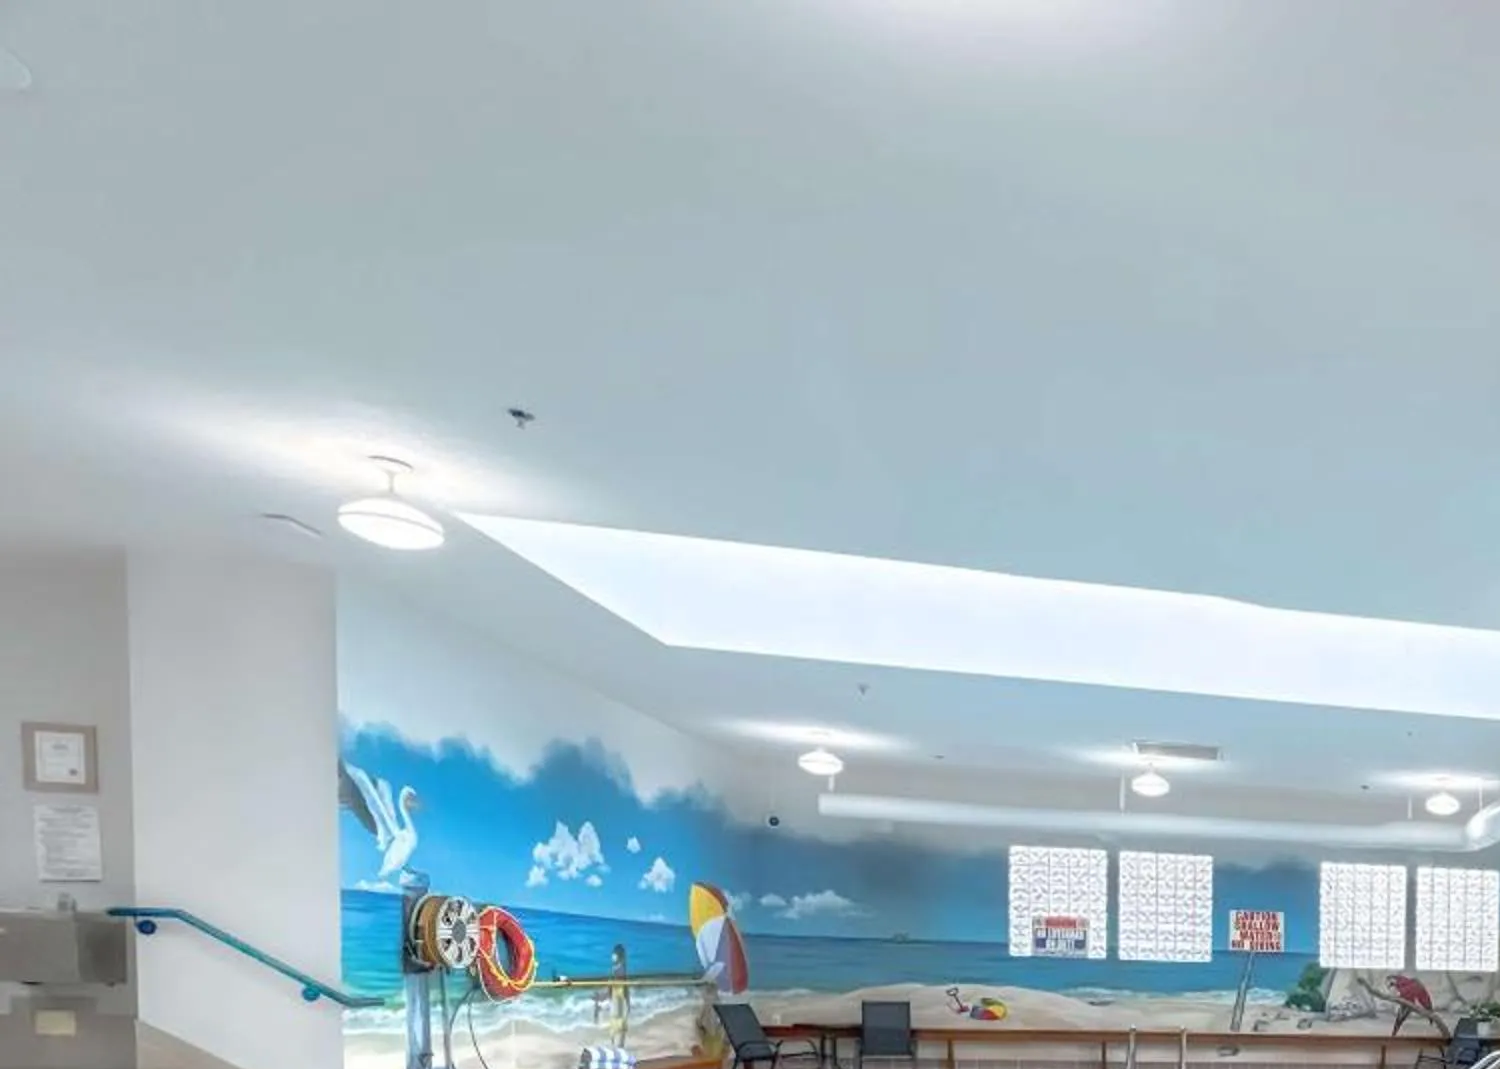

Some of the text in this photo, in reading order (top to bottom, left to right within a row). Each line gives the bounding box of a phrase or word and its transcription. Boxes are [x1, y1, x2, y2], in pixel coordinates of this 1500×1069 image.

[1235, 911, 1277, 921] CAUTION
[1234, 920, 1281, 931] SHALLOW
[1231, 940, 1281, 951] NO DIVING
